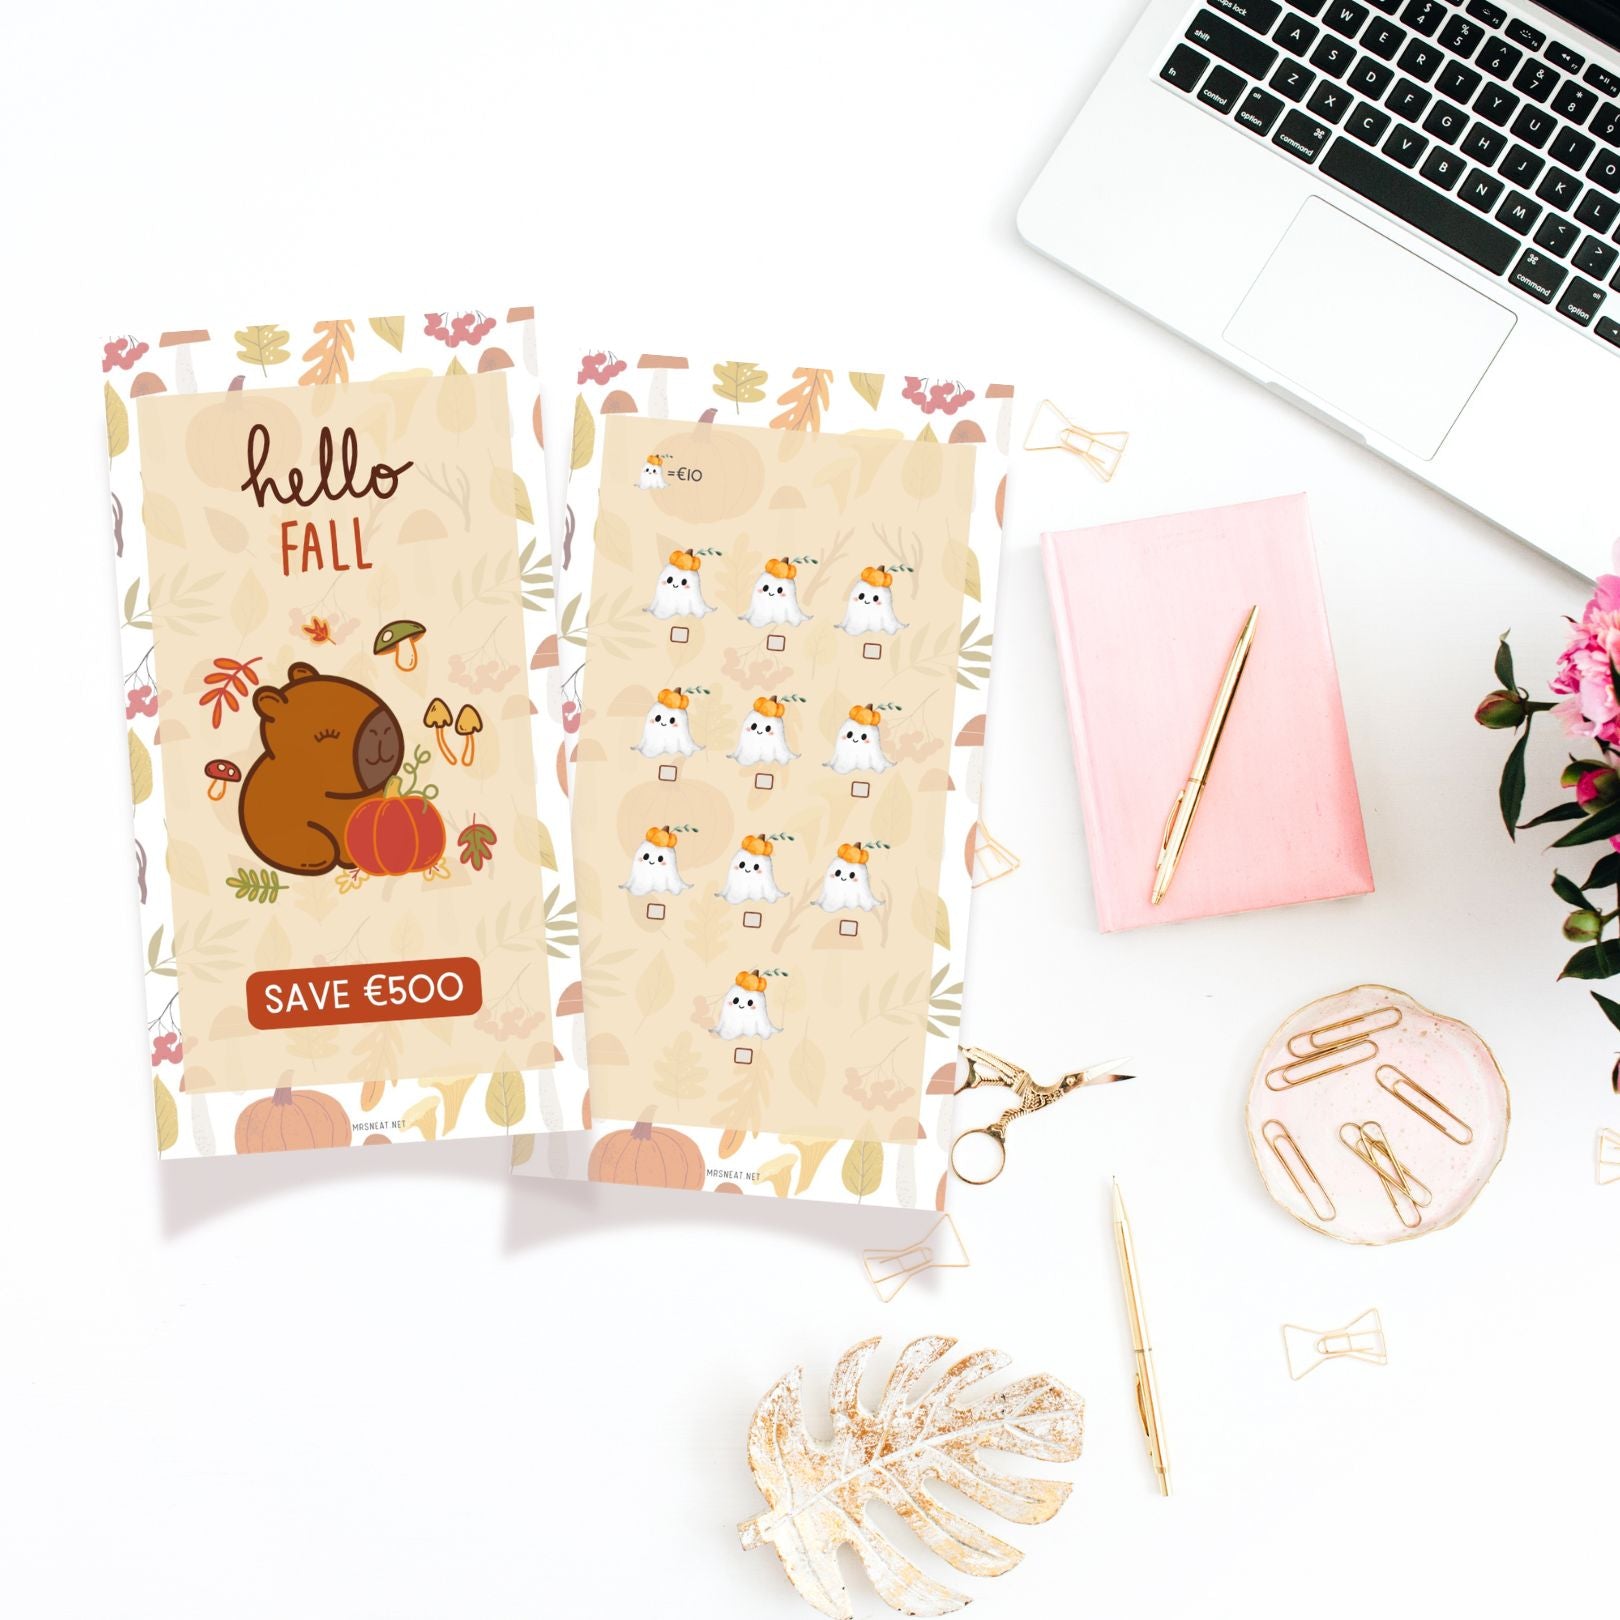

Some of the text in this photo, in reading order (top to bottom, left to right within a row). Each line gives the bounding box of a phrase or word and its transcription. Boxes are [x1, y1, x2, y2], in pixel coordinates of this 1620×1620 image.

[1232, 3, 1247, 17] lock
[1340, 8, 1354, 22] W
[1416, 15, 1426, 25] 4
[1193, 28, 1211, 42] shift
[1290, 28, 1301, 41] A
[1378, 31, 1389, 43] E
[1453, 36, 1463, 46] 5
[1328, 49, 1339, 61] S
[1416, 53, 1426, 66] R
[1491, 58, 1500, 68] 6
[1167, 66, 1177, 77] fn
[1365, 71, 1377, 83] D
[1287, 72, 1299, 85] Z
[1455, 75, 1465, 86] T
[1529, 79, 1539, 89] 7
[1202, 88, 1228, 106] control
[1324, 94, 1337, 108] X
[1404, 93, 1415, 104] F
[1493, 96, 1504, 108] Y
[1567, 102, 1576, 112] 8
[1240, 110, 1263, 127] option
[1363, 117, 1374, 129] C
[1441, 116, 1453, 127] G
[1529, 119, 1541, 131] U
[1606, 124, 1615, 134] 9
[1279, 133, 1314, 157] command
[1402, 138, 1412, 150] V
[1478, 136, 1490, 150] H
[1438, 161, 1449, 173] B
[1517, 161, 1527, 172] J
[1605, 164, 1616, 175] O
[1475, 183, 1488, 196] N
[1555, 181, 1566, 194] K
[1512, 205, 1526, 219] M
[1593, 205, 1601, 217] L
[1516, 272, 1552, 297] command
[1567, 303, 1590, 321] option
[241, 424, 414, 508] hello
[281, 517, 373, 577] FALL
[265, 971, 464, 1014] SAVE €500
